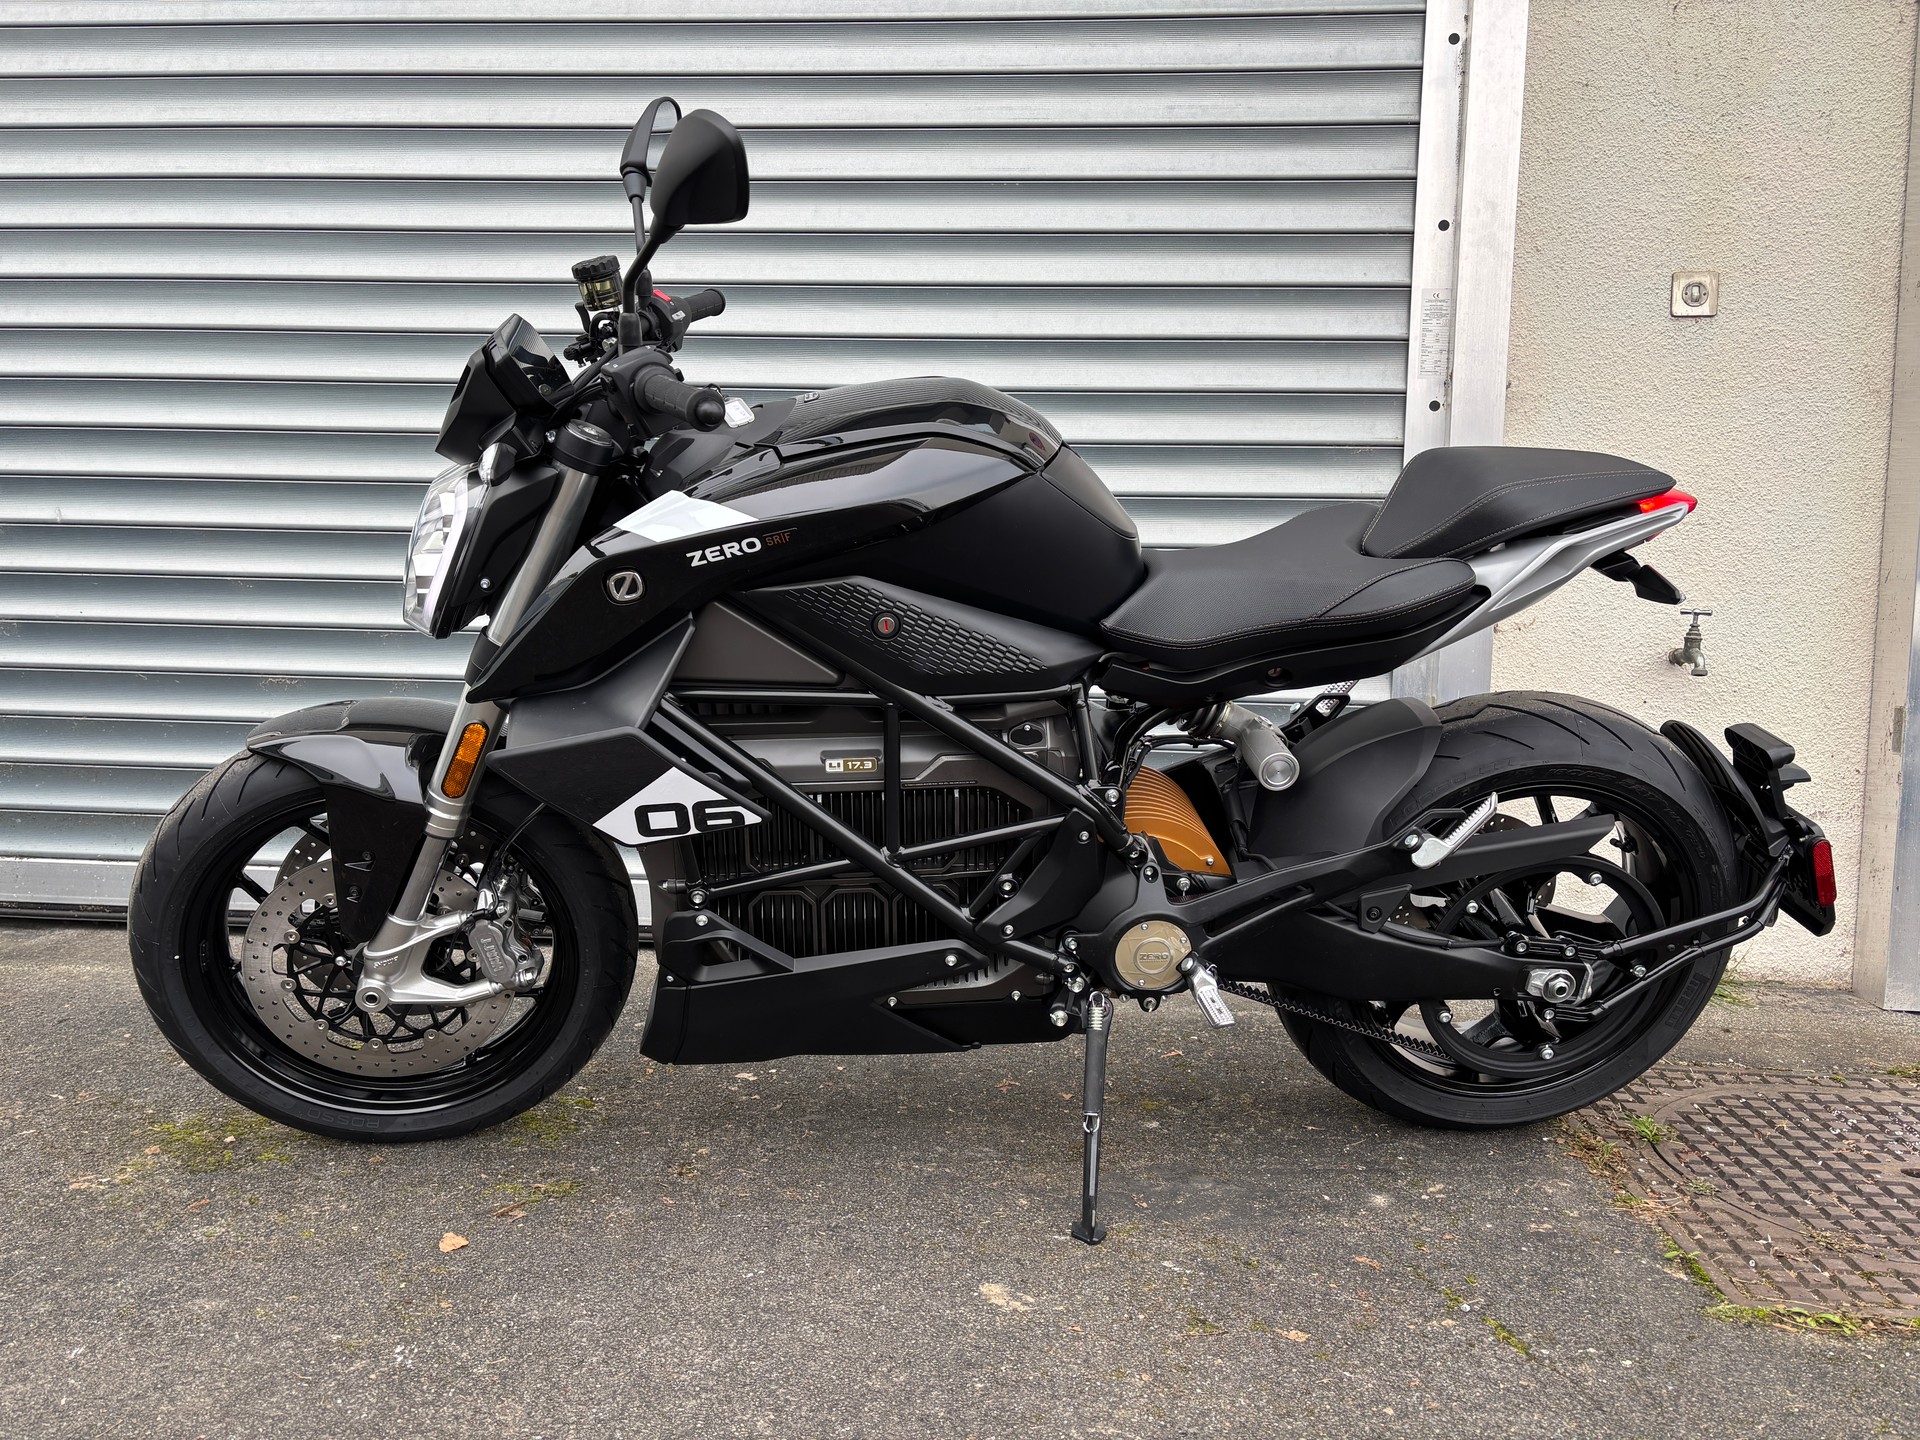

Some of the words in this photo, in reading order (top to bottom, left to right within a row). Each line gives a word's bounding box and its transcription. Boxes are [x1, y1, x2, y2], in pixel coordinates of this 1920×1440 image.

[685, 537, 762, 567] ZERO
[846, 761, 872, 770] 17.3
[634, 799, 746, 837] 06
[1139, 952, 1169, 961] ZERO
[306, 1107, 381, 1128] ROSSO
